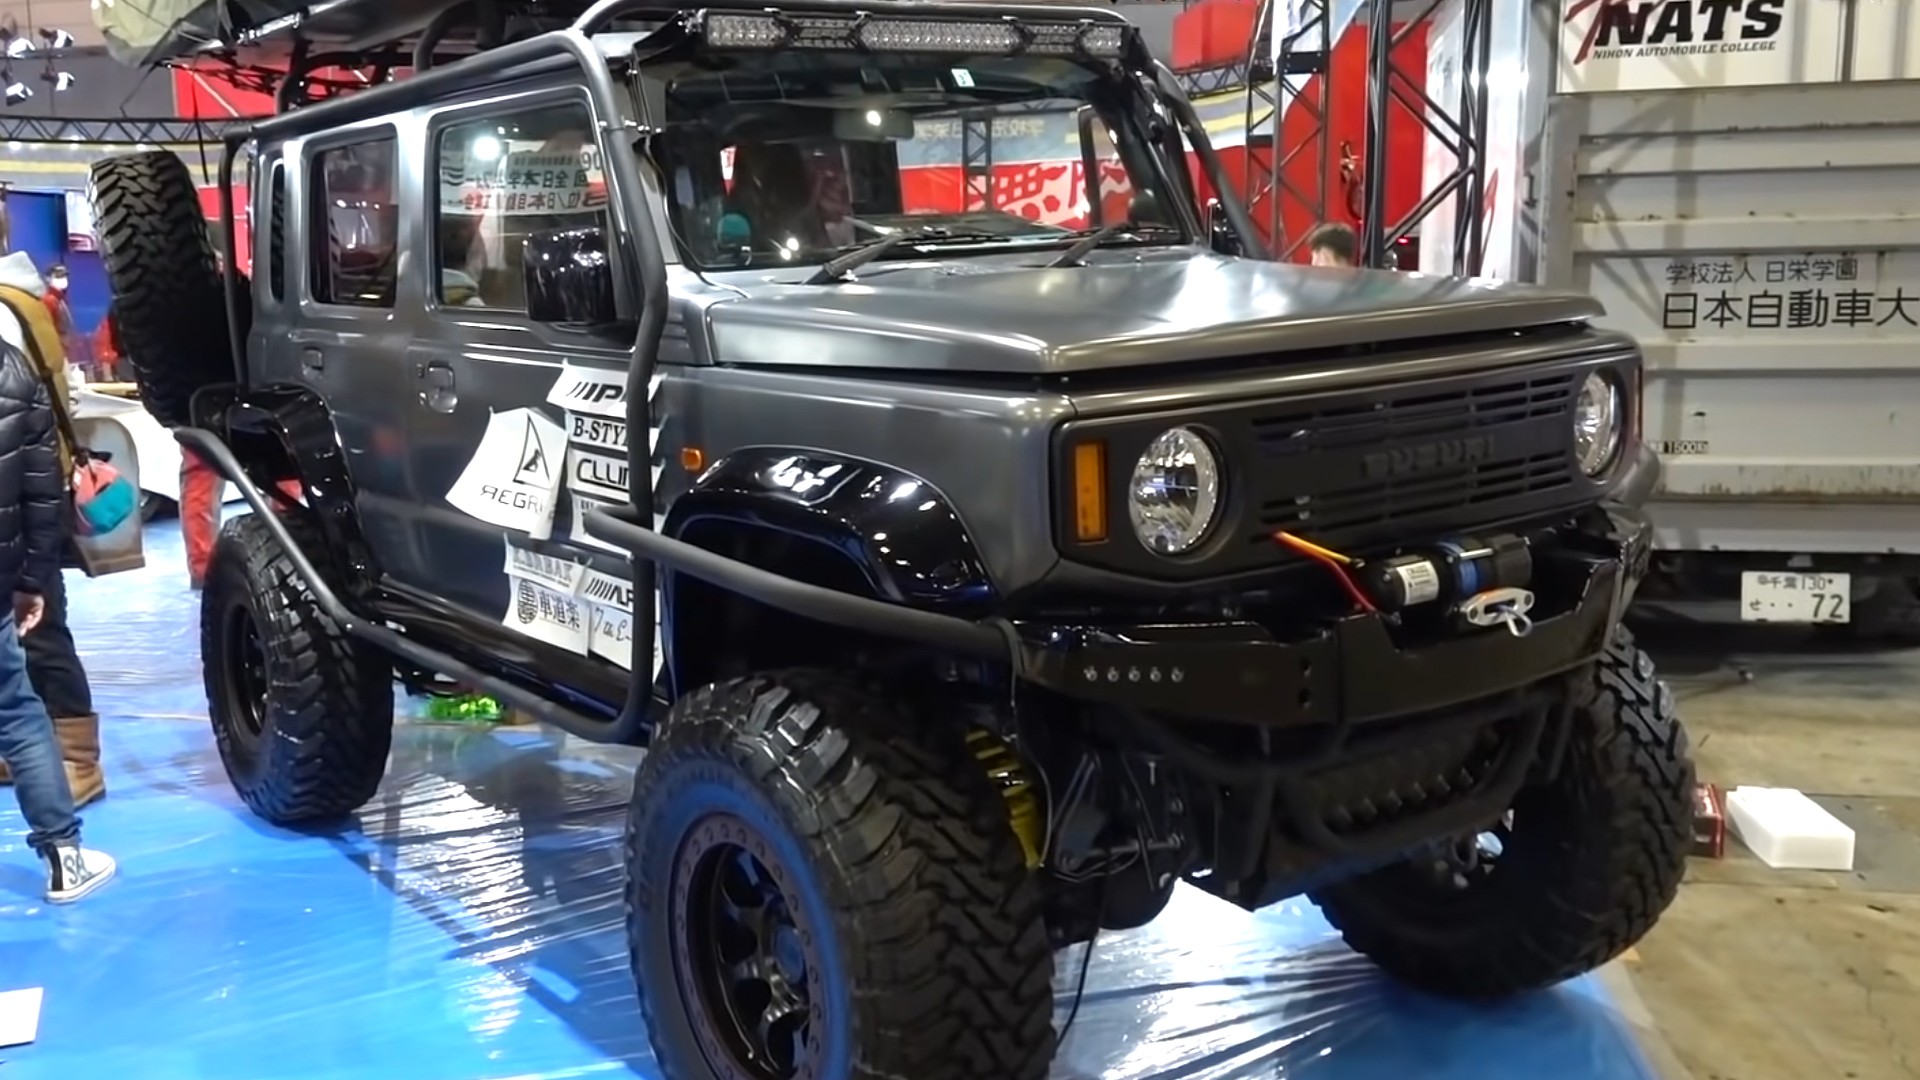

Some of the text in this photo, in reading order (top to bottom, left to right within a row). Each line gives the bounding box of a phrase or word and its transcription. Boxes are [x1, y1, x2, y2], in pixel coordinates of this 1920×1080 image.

[1595, 0, 1785, 46] NATS
[1593, 40, 1777, 60] NIHON AUTOMOBILE COLLEGE
[1665, 257, 1858, 285] 学校法人 日栄学園
[1663, 287, 1919, 330] 日本自動車大
[1801, 574, 1826, 591] 130
